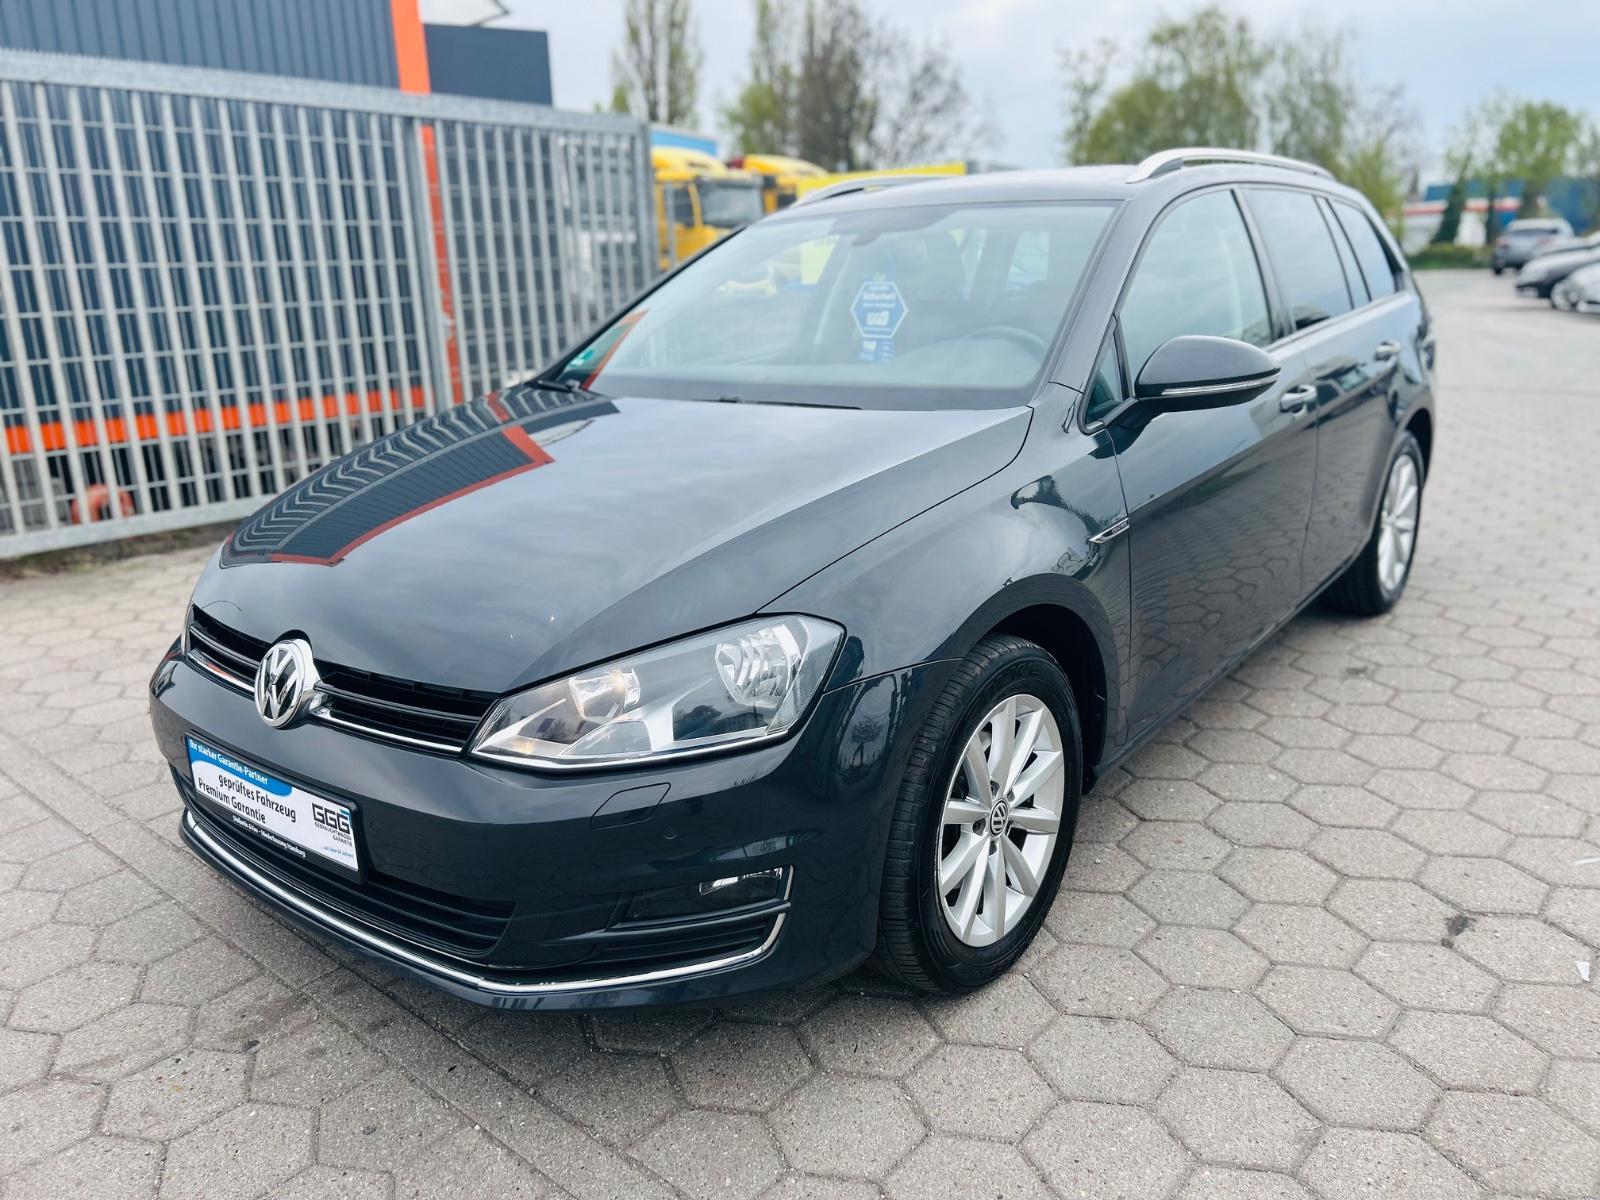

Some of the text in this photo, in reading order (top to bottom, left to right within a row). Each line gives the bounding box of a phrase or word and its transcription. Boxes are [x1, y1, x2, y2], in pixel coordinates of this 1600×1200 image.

[198, 745, 217, 761] starker
[217, 753, 268, 785] Garantie-Partner
[198, 777, 266, 824] Premium Garantie
[218, 774, 296, 823] geprüftes Fahrzeug
[312, 802, 351, 835] GGG
